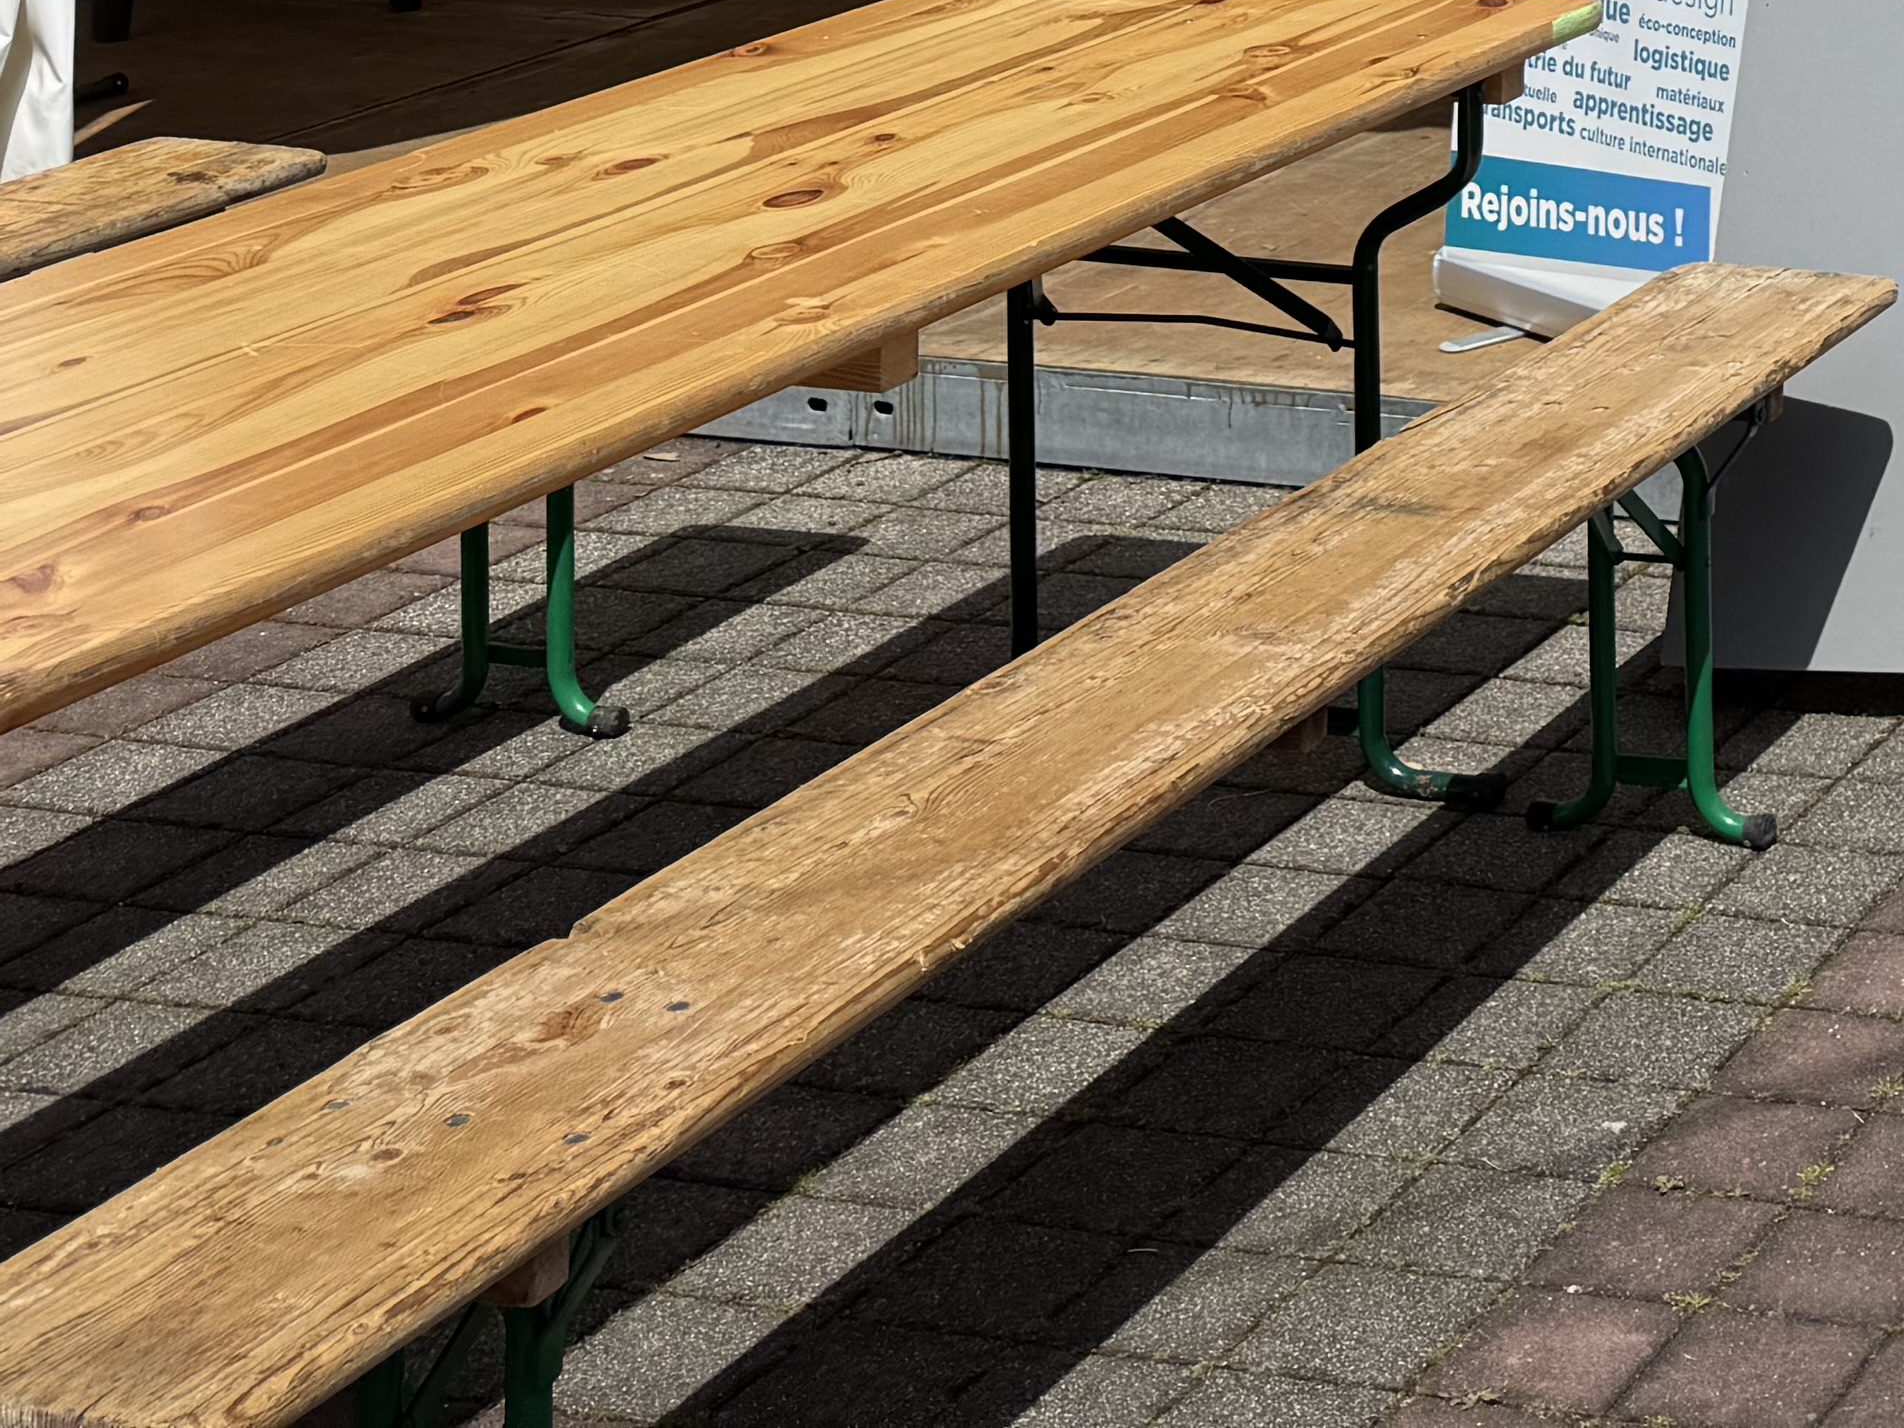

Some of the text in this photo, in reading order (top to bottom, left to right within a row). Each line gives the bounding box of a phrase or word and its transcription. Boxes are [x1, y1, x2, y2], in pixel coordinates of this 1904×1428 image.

[1638, 14, 1737, 48] éco-conception
[1562, 56, 1725, 114] du futur matériaux
[1633, 38, 1730, 82] logistique
[1573, 88, 1714, 143] apprentissage
[1579, 125, 1727, 177] culture internationale
[1461, 181, 1684, 247] Rejoins-nous !
